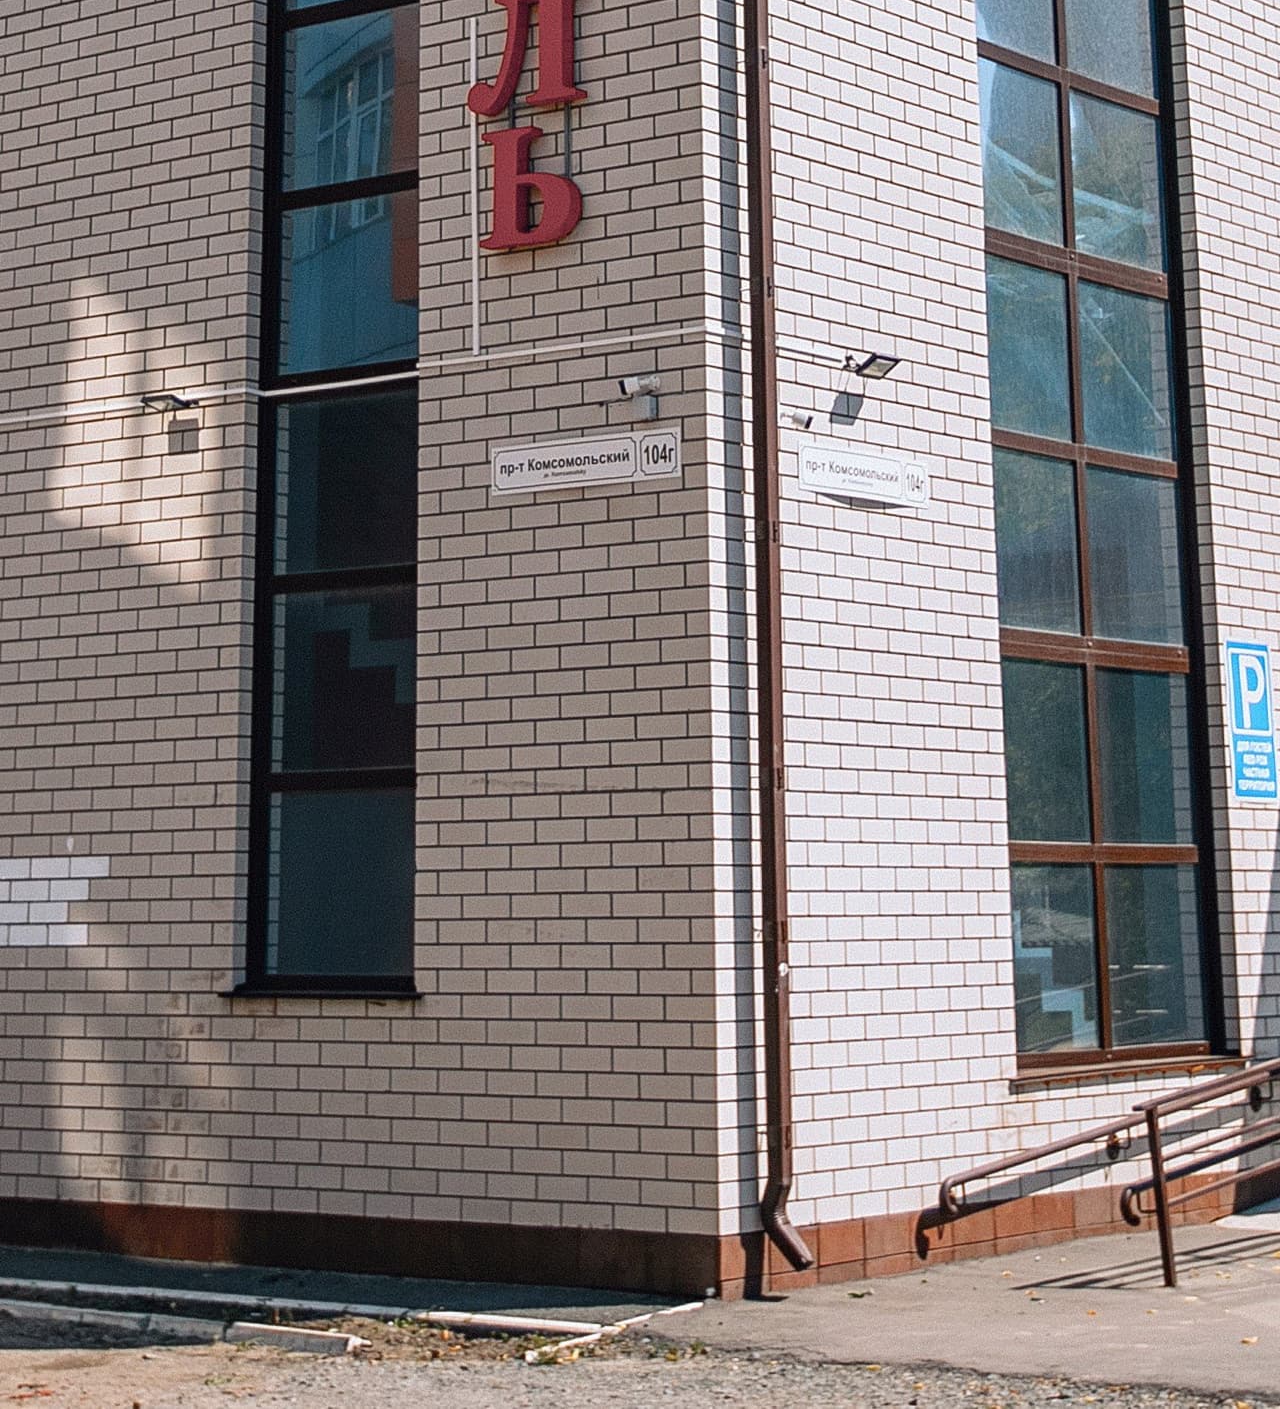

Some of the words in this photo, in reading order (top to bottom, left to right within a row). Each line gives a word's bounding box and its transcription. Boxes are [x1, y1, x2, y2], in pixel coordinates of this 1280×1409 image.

[499, 462, 525, 477] пр-т
[527, 448, 630, 472] Комсомольский
[643, 443, 675, 466] 104г
[805, 459, 826, 475] пр-т
[828, 461, 899, 483] Комсомольский
[1238, 654, 1266, 729] P
